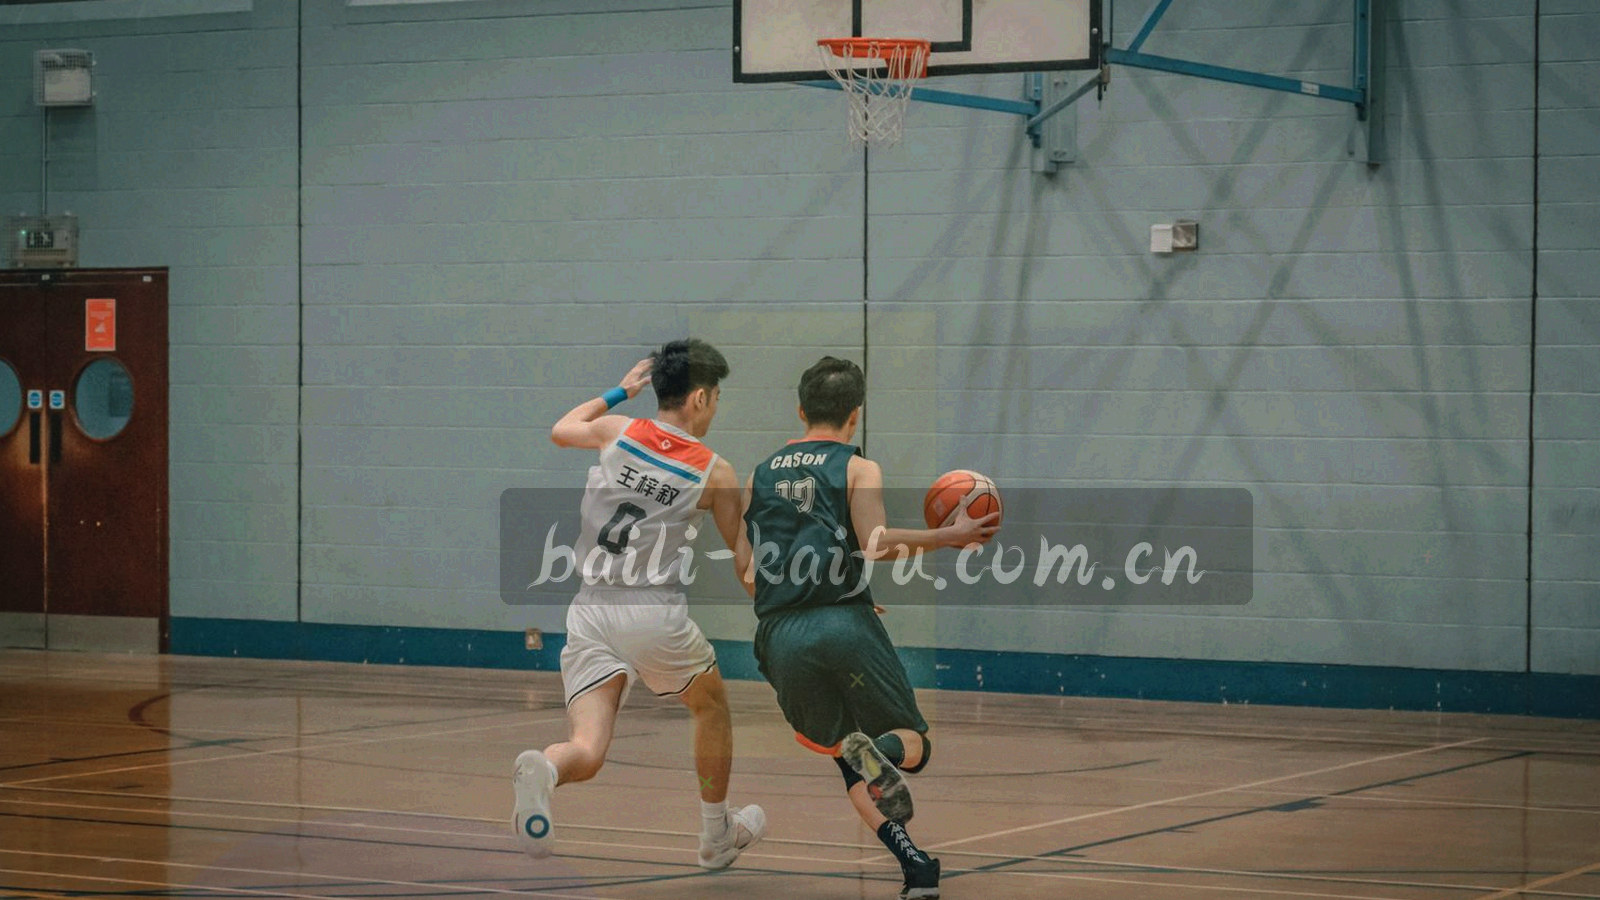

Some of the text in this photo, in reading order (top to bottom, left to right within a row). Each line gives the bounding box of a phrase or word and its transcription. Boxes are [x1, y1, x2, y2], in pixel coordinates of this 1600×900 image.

[770, 452, 828, 470] CASON
[616, 465, 680, 506] 王梓叙
[597, 502, 647, 555] 0
